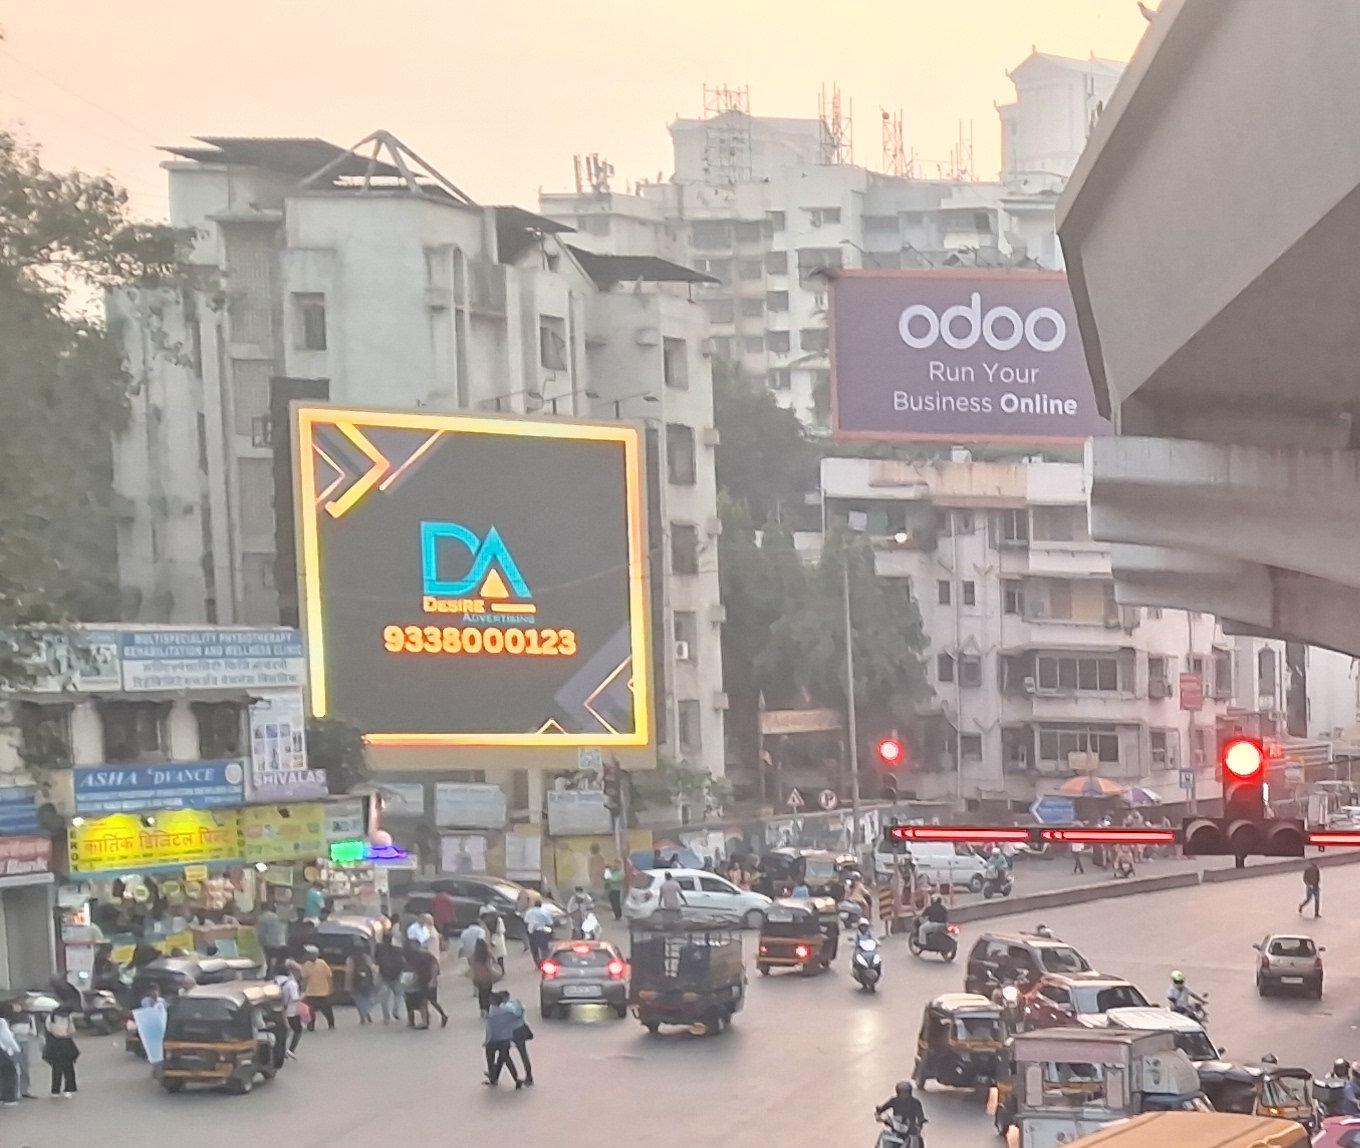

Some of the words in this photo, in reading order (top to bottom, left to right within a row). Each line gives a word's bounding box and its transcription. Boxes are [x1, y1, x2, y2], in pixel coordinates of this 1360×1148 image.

[899, 292, 1066, 351] odoo
[929, 361, 975, 383] Run
[982, 362, 1039, 384] Your
[893, 391, 993, 413] Business
[1000, 392, 1078, 415] Online
[420, 521, 533, 598] DA
[383, 625, 577, 656] 9338000123
[80, 771, 138, 788] ASHA
[147, 768, 214, 785] DVANCE
